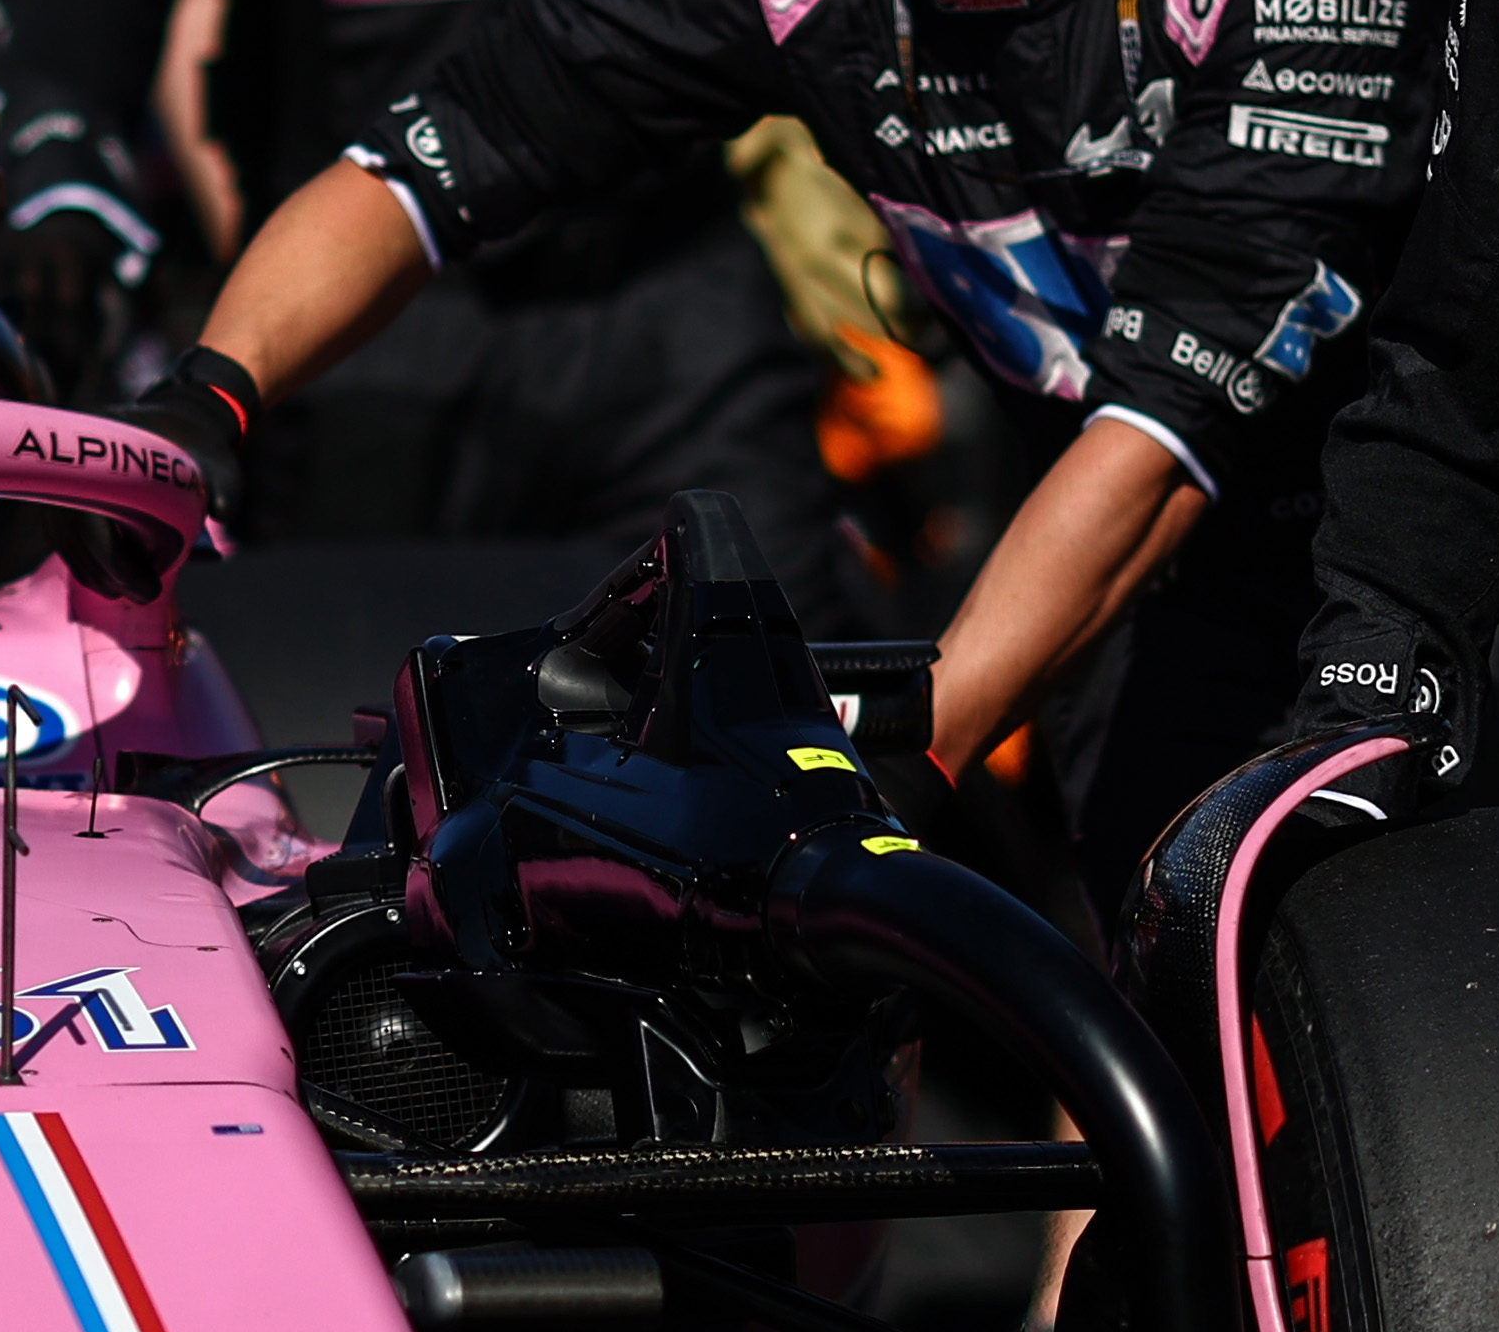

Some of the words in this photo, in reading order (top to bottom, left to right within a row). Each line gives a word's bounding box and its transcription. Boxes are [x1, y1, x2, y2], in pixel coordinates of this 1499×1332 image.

[1274, 67, 1396, 101] ecowatt
[1227, 102, 1391, 168] PIRELLI
[1169, 330, 1236, 388] Bell
[1319, 662, 1399, 695] Ross
